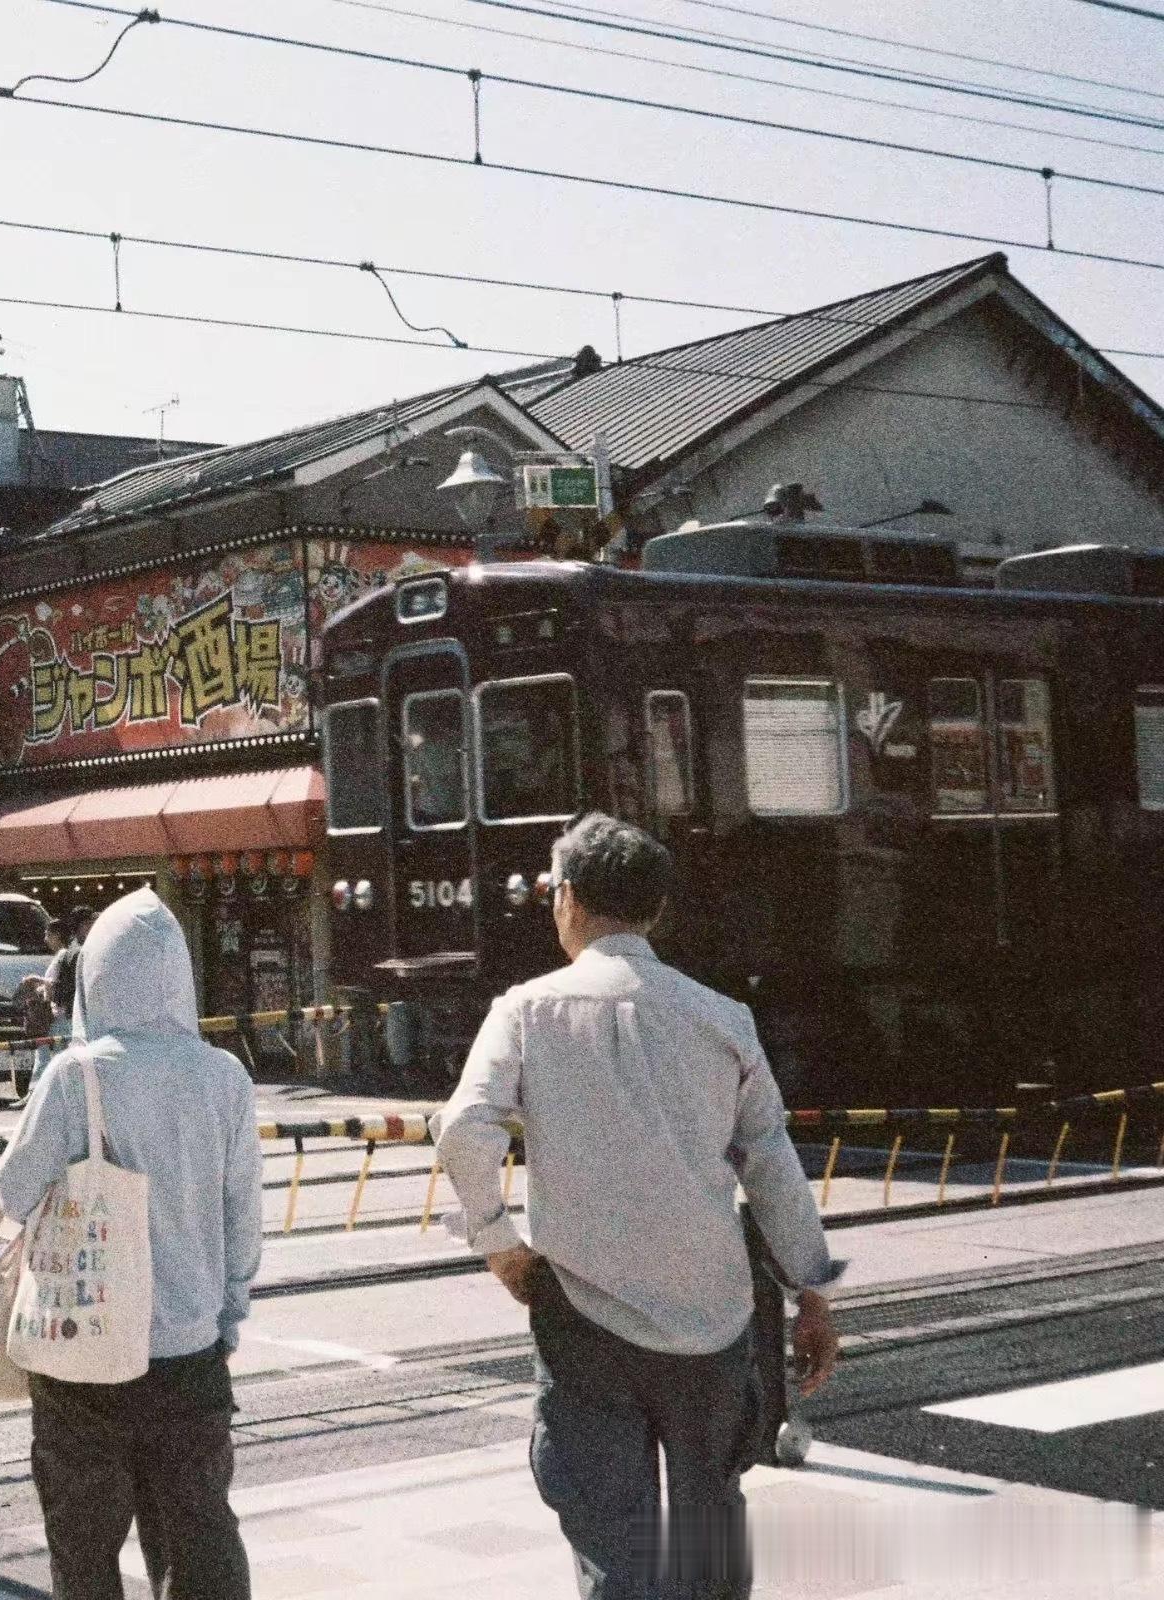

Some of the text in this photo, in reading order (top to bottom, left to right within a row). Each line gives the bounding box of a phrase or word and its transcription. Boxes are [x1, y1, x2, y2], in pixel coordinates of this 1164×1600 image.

[32, 591, 282, 739] ジャンボ酒場
[408, 880, 474, 908] 5104
